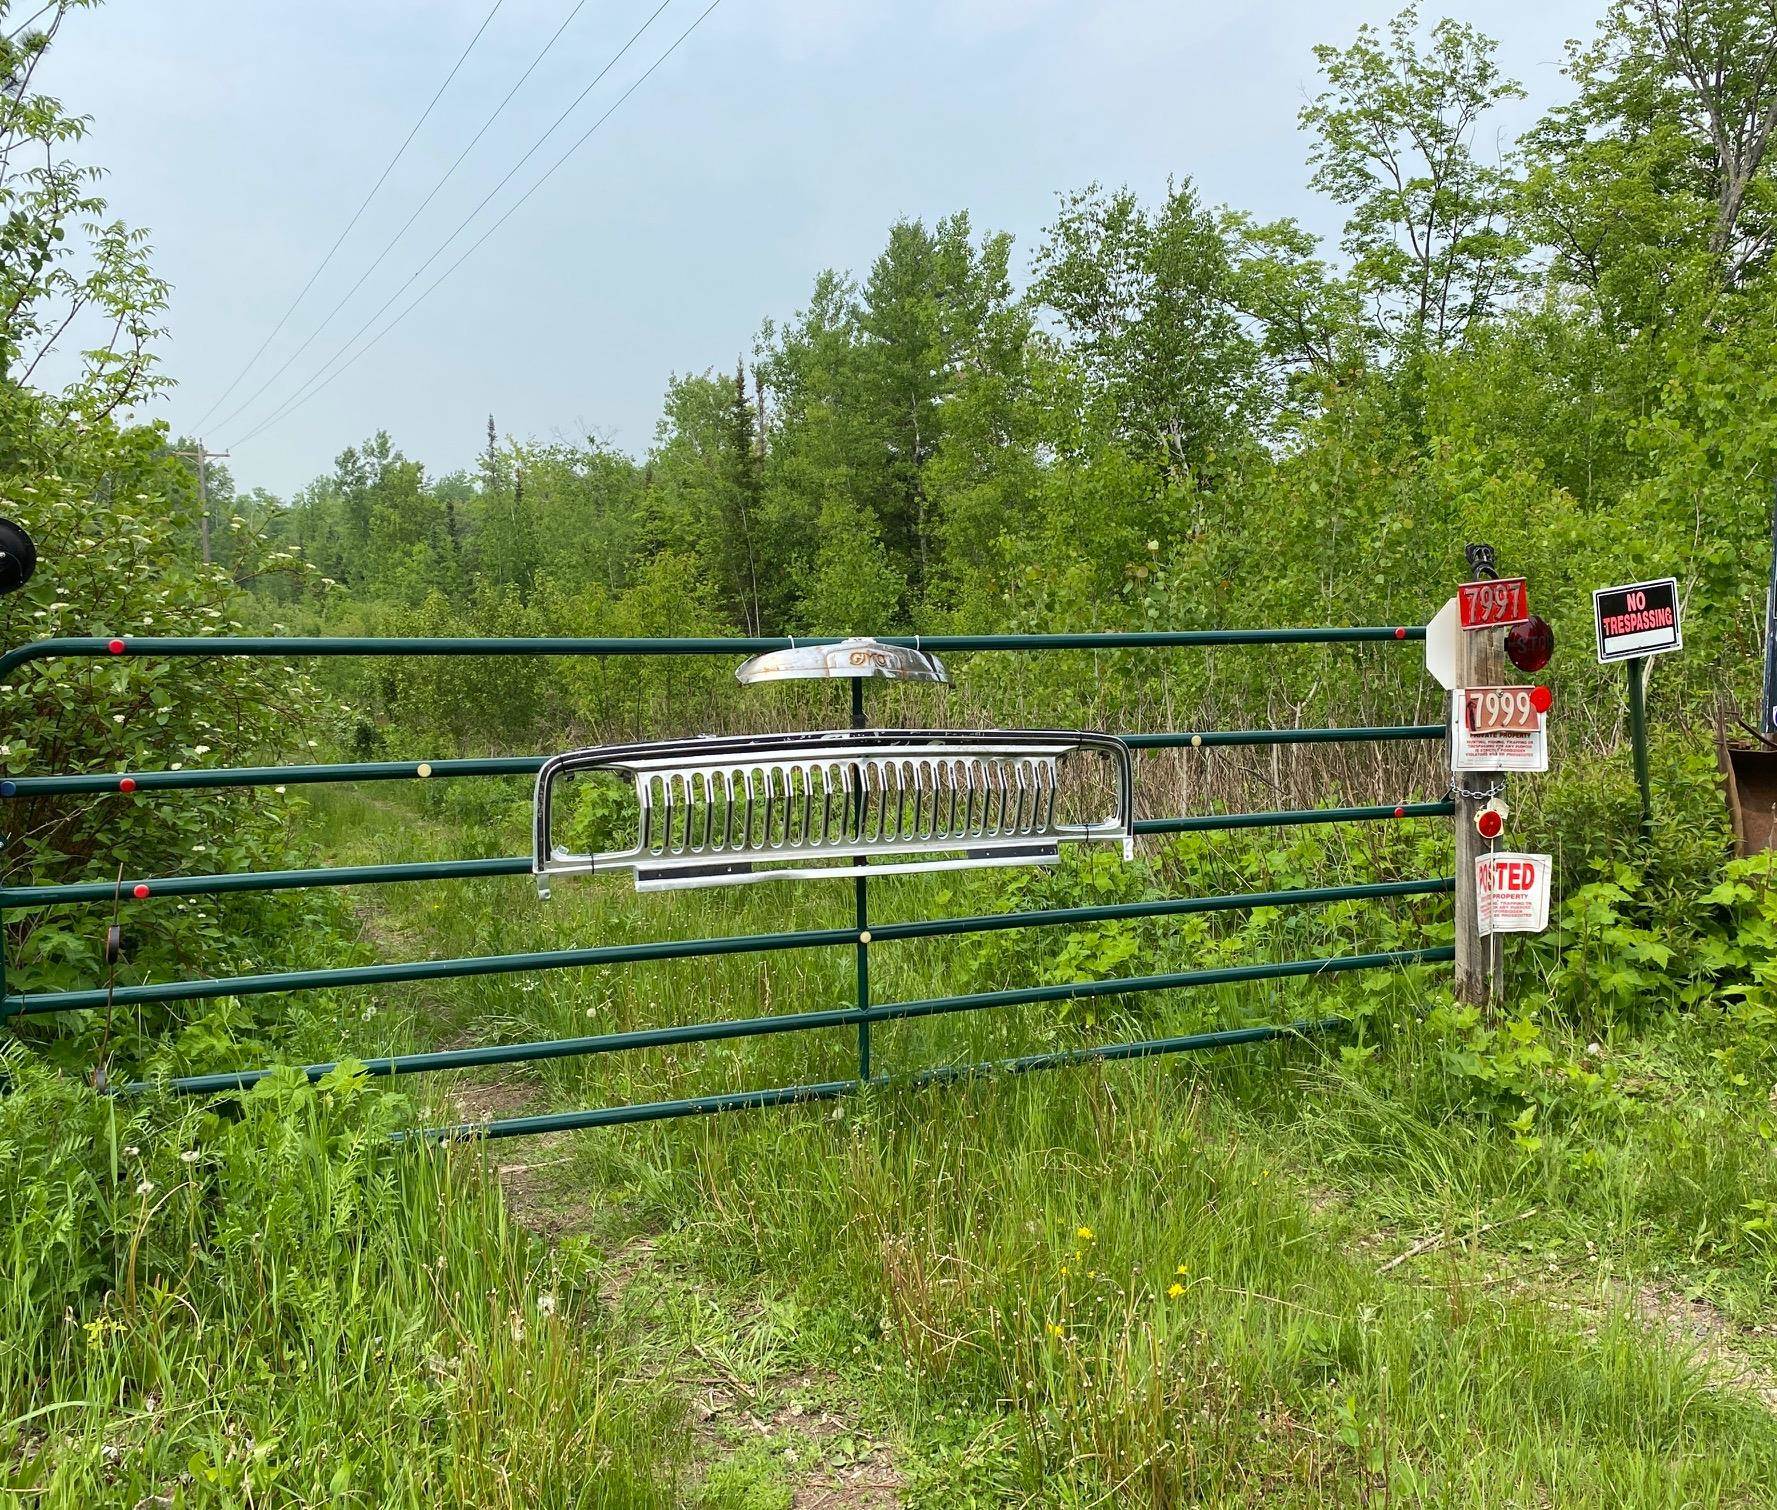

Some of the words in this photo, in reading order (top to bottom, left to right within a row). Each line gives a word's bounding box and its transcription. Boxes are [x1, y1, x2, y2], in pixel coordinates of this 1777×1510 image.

[1626, 591, 1646, 612] NO
[1603, 606, 1673, 636] TRESPASSING
[1470, 691, 1531, 729] 7999
[1500, 731, 1531, 739] PROPERTY
